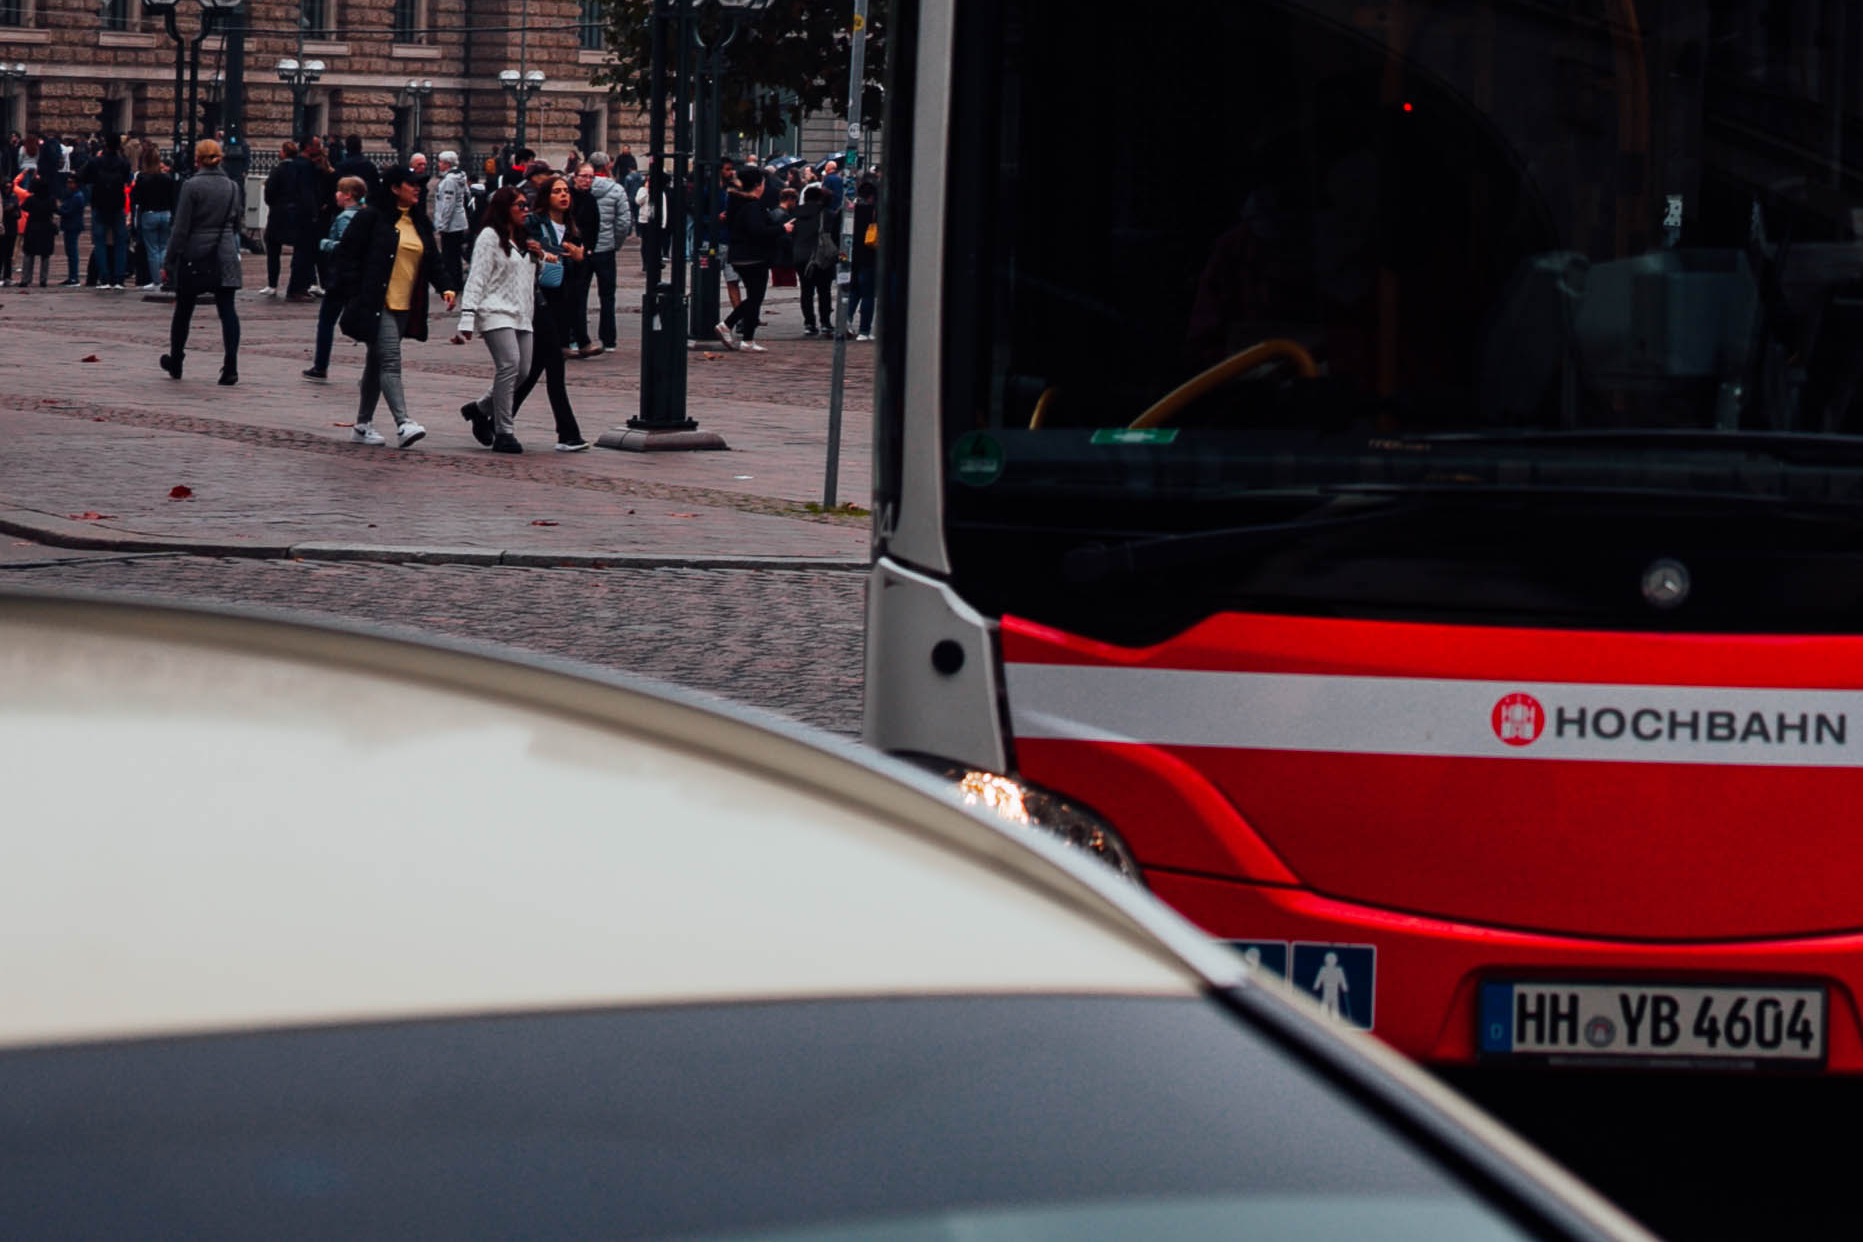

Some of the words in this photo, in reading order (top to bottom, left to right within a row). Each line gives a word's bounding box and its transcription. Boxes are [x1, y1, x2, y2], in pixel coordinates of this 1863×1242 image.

[1555, 706, 1848, 745] HOCHBAHN
[1516, 992, 1580, 1045] HH
[1618, 993, 1681, 1048] YB
[1693, 995, 1814, 1050] 4604
